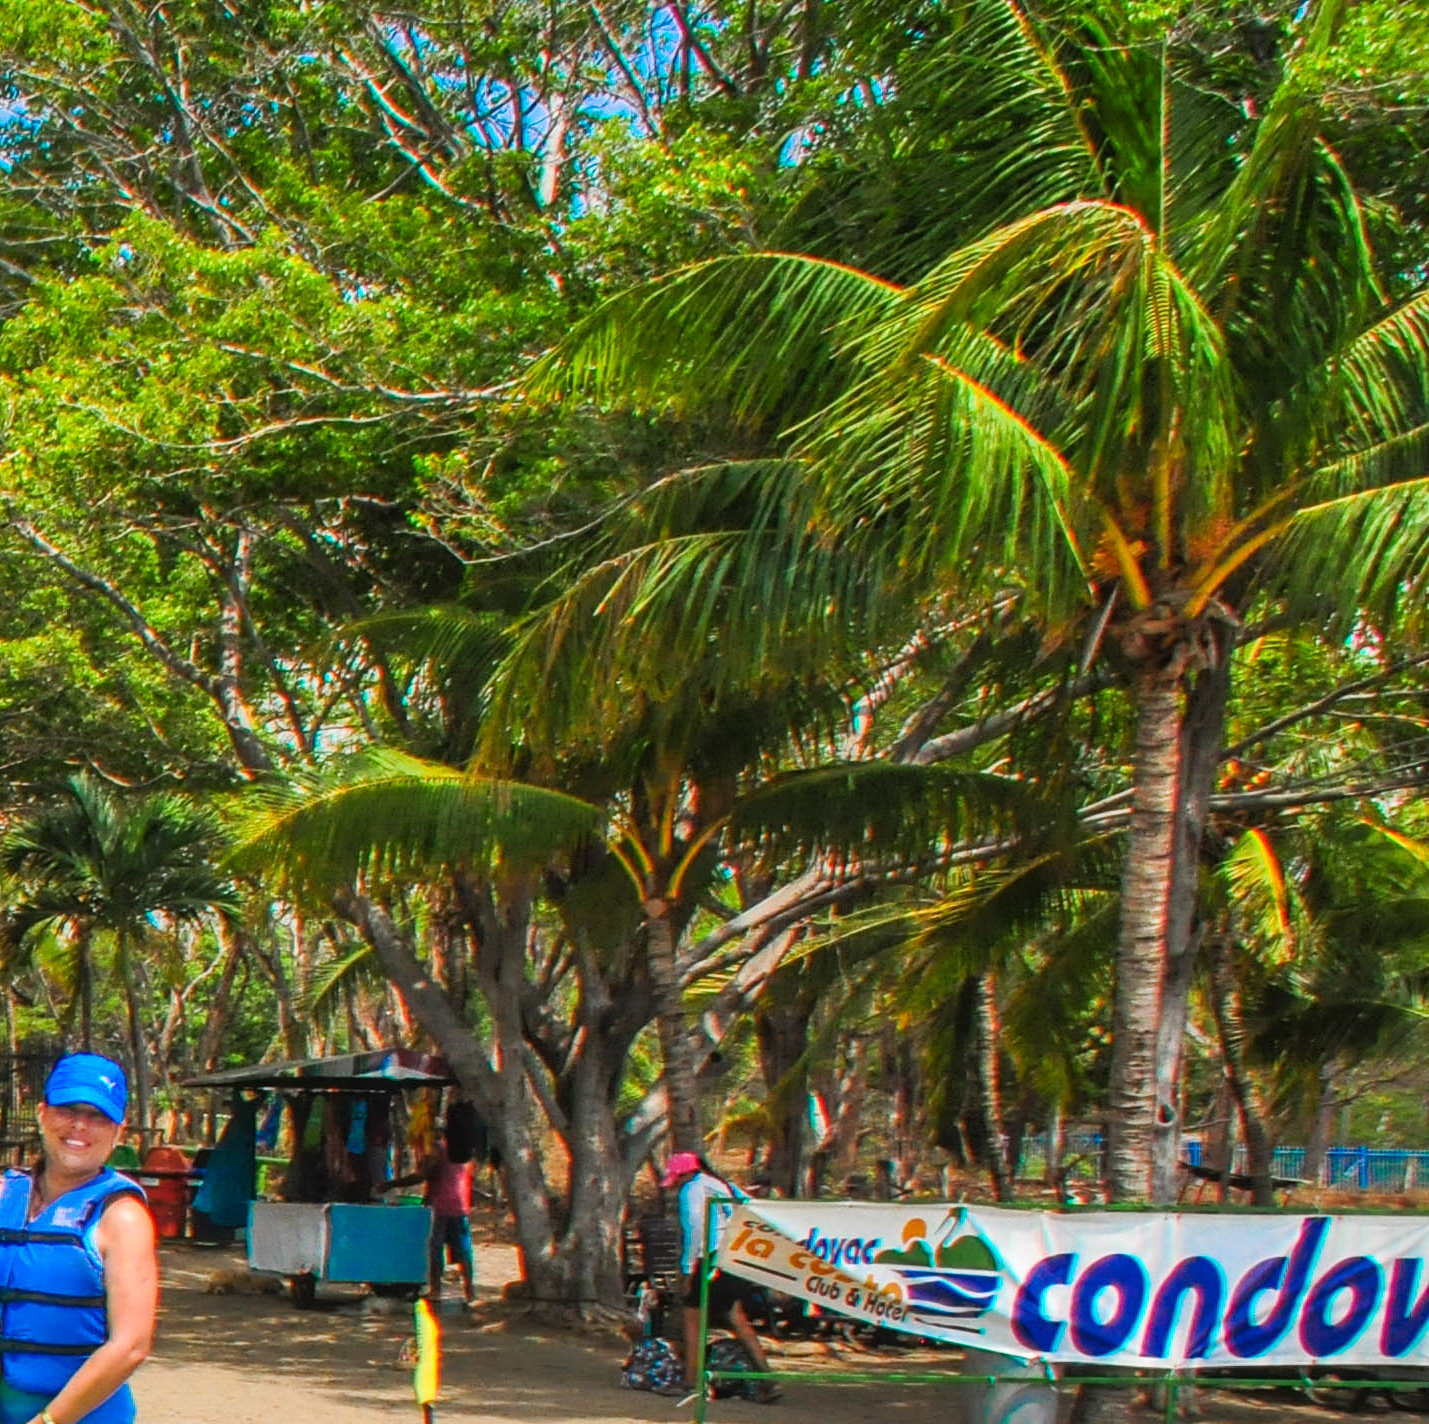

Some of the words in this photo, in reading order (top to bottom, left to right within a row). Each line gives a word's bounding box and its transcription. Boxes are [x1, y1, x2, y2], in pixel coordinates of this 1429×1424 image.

[729, 1228, 776, 1260] la
[805, 1275, 841, 1301] Club
[844, 1287, 861, 1308] &
